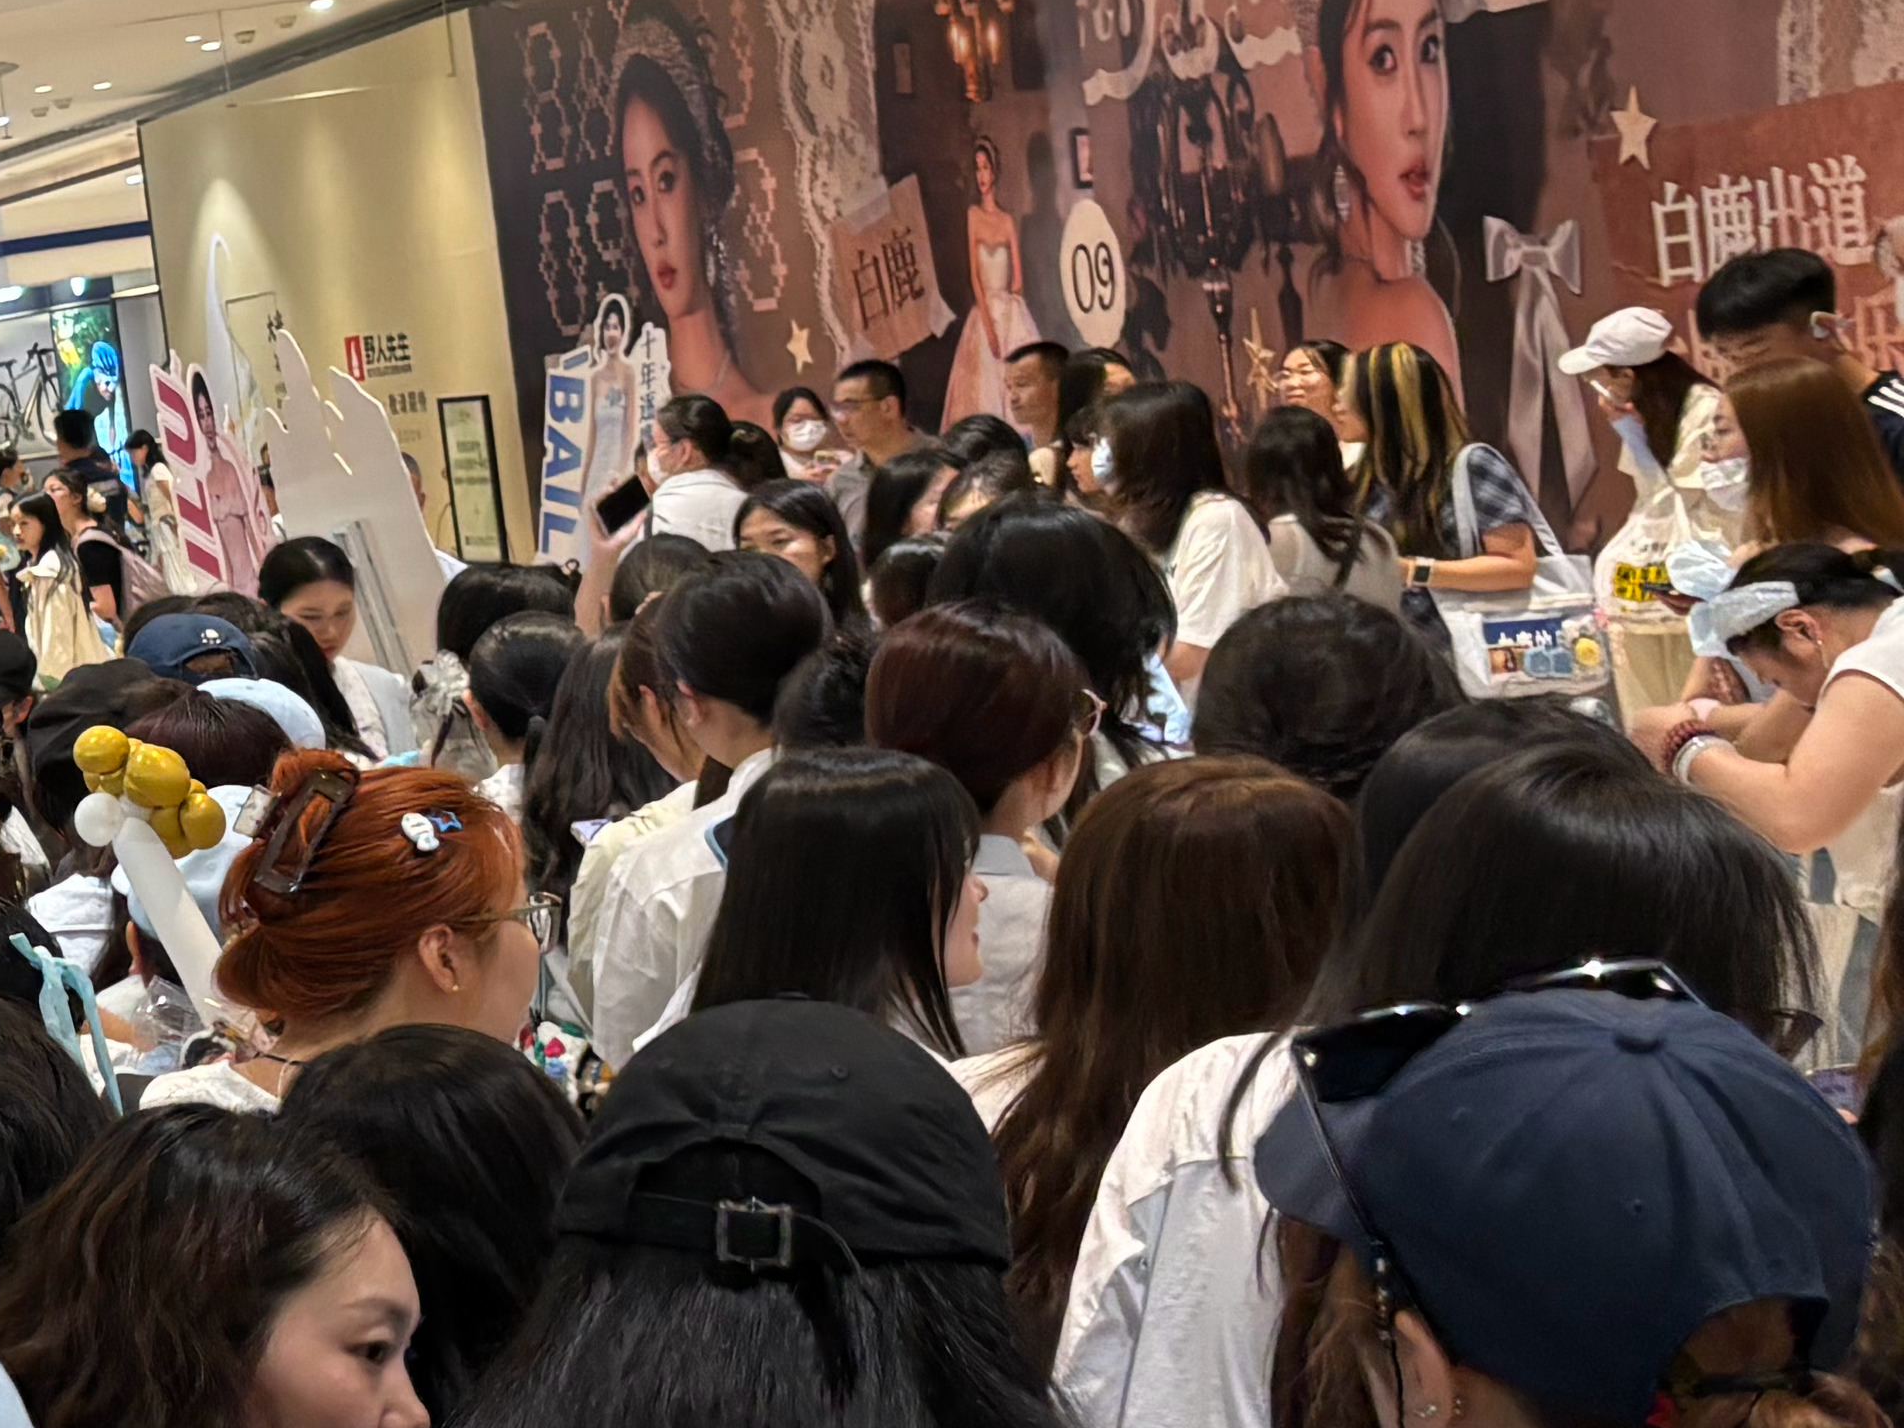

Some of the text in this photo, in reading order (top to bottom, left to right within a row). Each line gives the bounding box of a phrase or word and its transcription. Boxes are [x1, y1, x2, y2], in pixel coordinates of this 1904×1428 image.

[852, 227, 925, 330] 白鹿
[1072, 241, 1116, 314] 09
[362, 332, 411, 366] 野人先生
